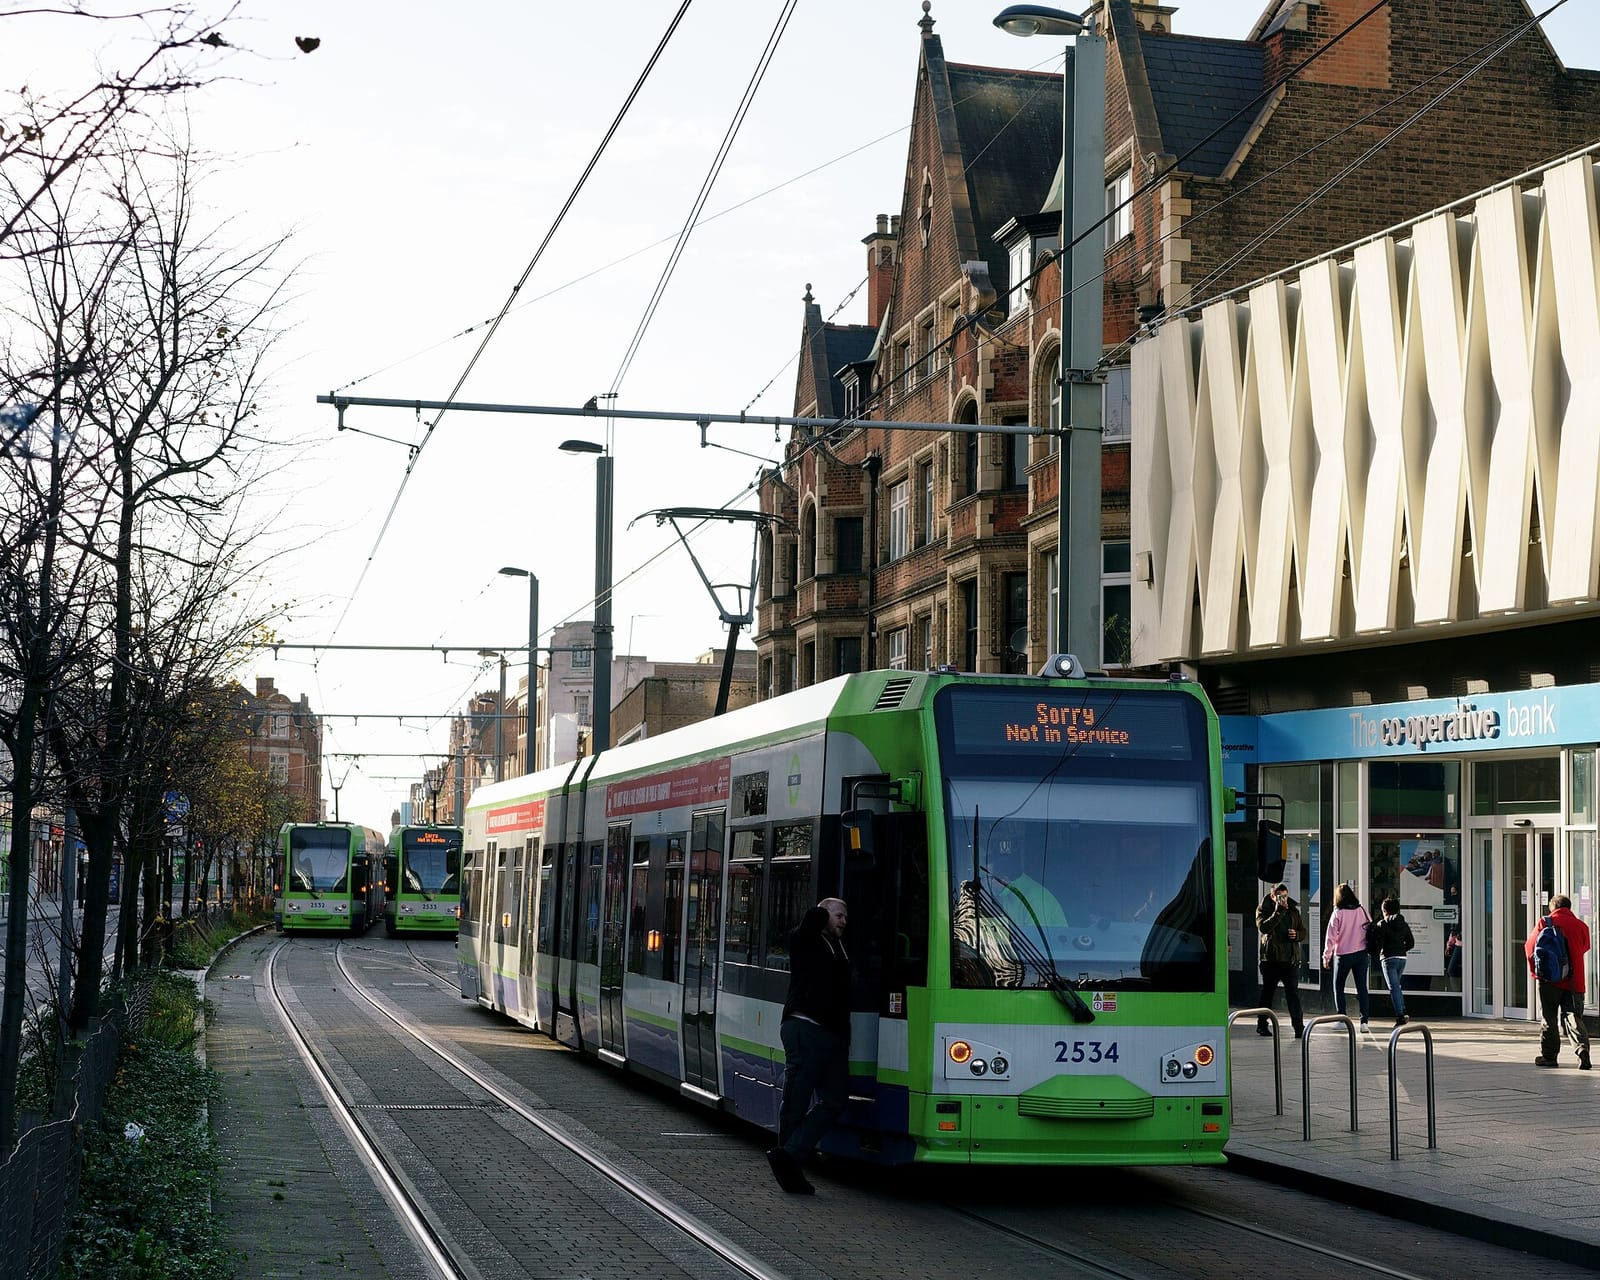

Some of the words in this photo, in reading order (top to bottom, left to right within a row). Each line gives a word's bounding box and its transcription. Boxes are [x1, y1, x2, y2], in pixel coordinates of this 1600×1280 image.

[1036, 703, 1094, 726] Sorry
[1349, 712, 1377, 748] The
[1379, 703, 1500, 751] co-operative
[1507, 695, 1556, 737] bank
[1006, 724, 1038, 743] Not
[1044, 725, 1061, 743] in
[1067, 726, 1129, 744] Service
[1054, 1041, 1120, 1064] 2534
